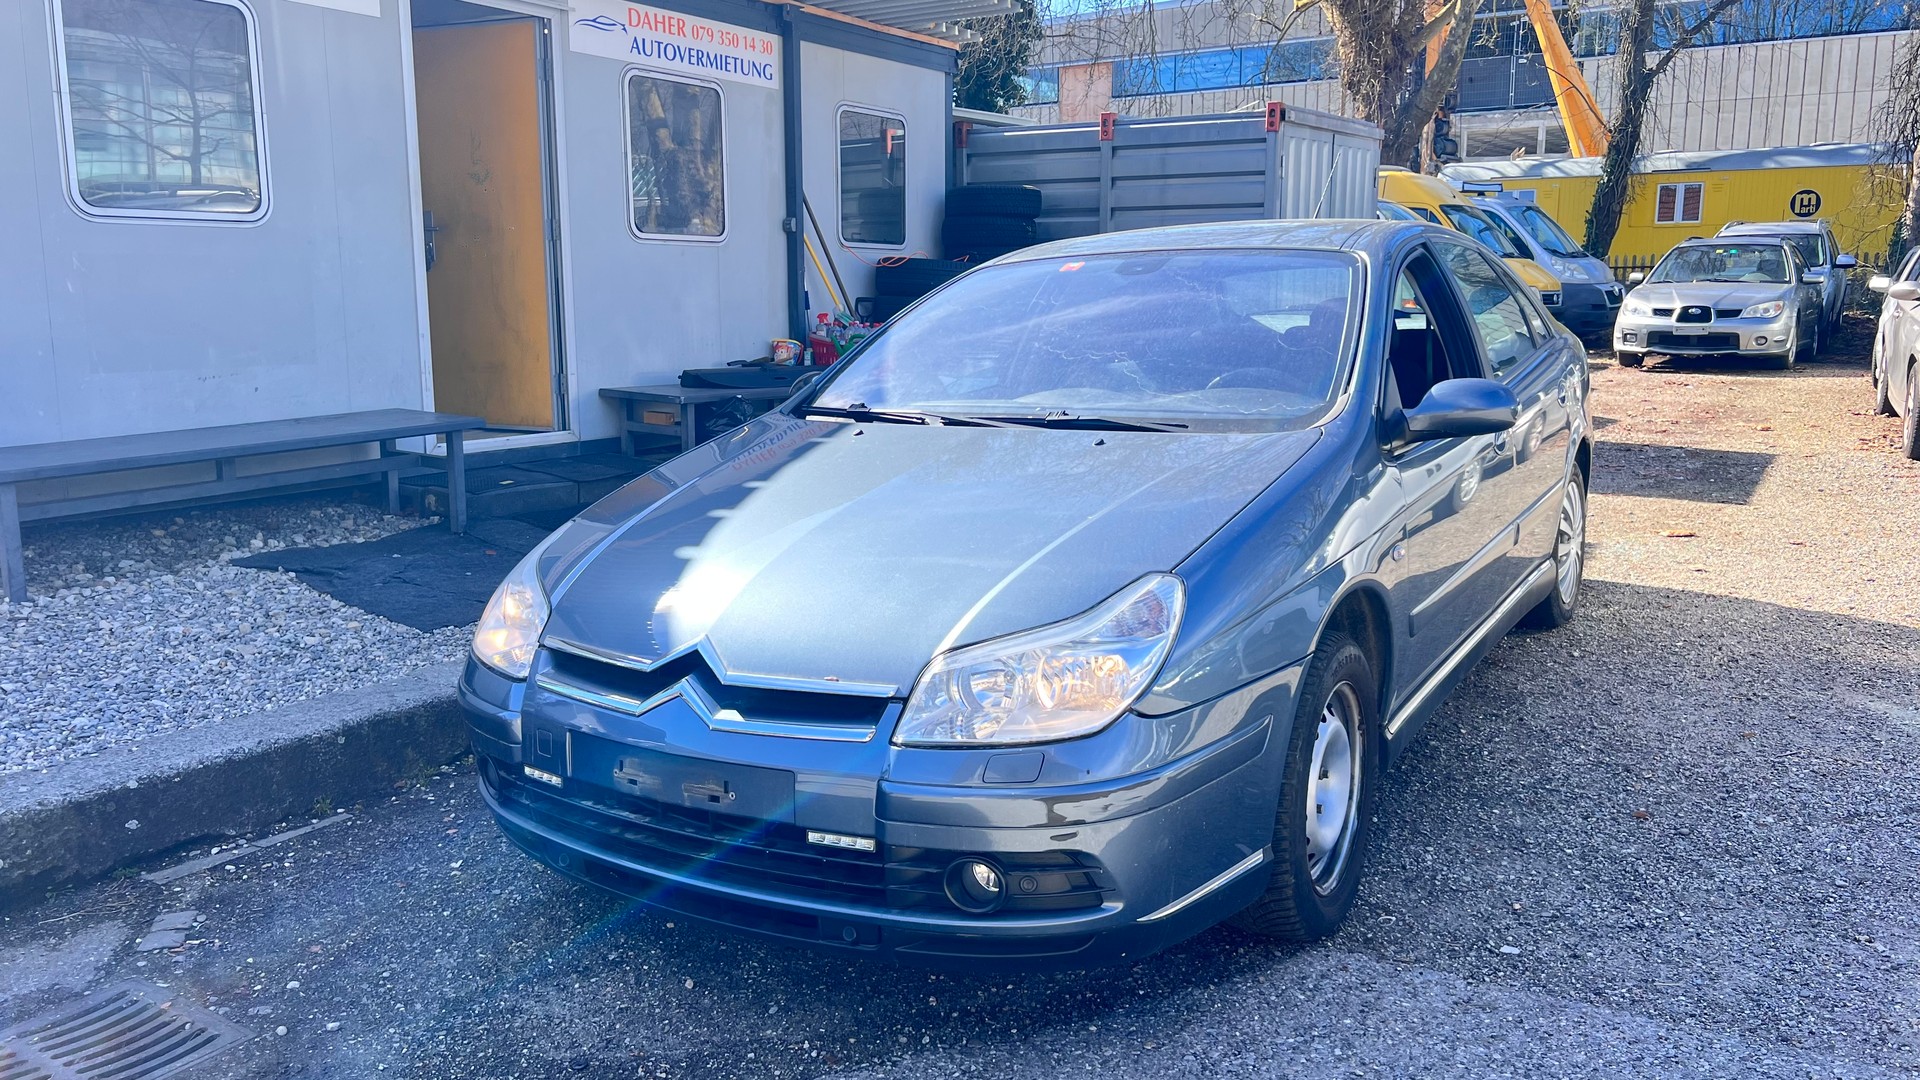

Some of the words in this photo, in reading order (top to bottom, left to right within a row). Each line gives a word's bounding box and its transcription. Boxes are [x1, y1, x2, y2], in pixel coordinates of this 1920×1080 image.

[628, 7, 687, 38] DAHER
[691, 24, 714, 43] 079
[717, 29, 739, 48] 350
[743, 35, 756, 52] 14
[759, 38, 773, 55] 30
[630, 36, 773, 80] AUTOVERMIETUNG
